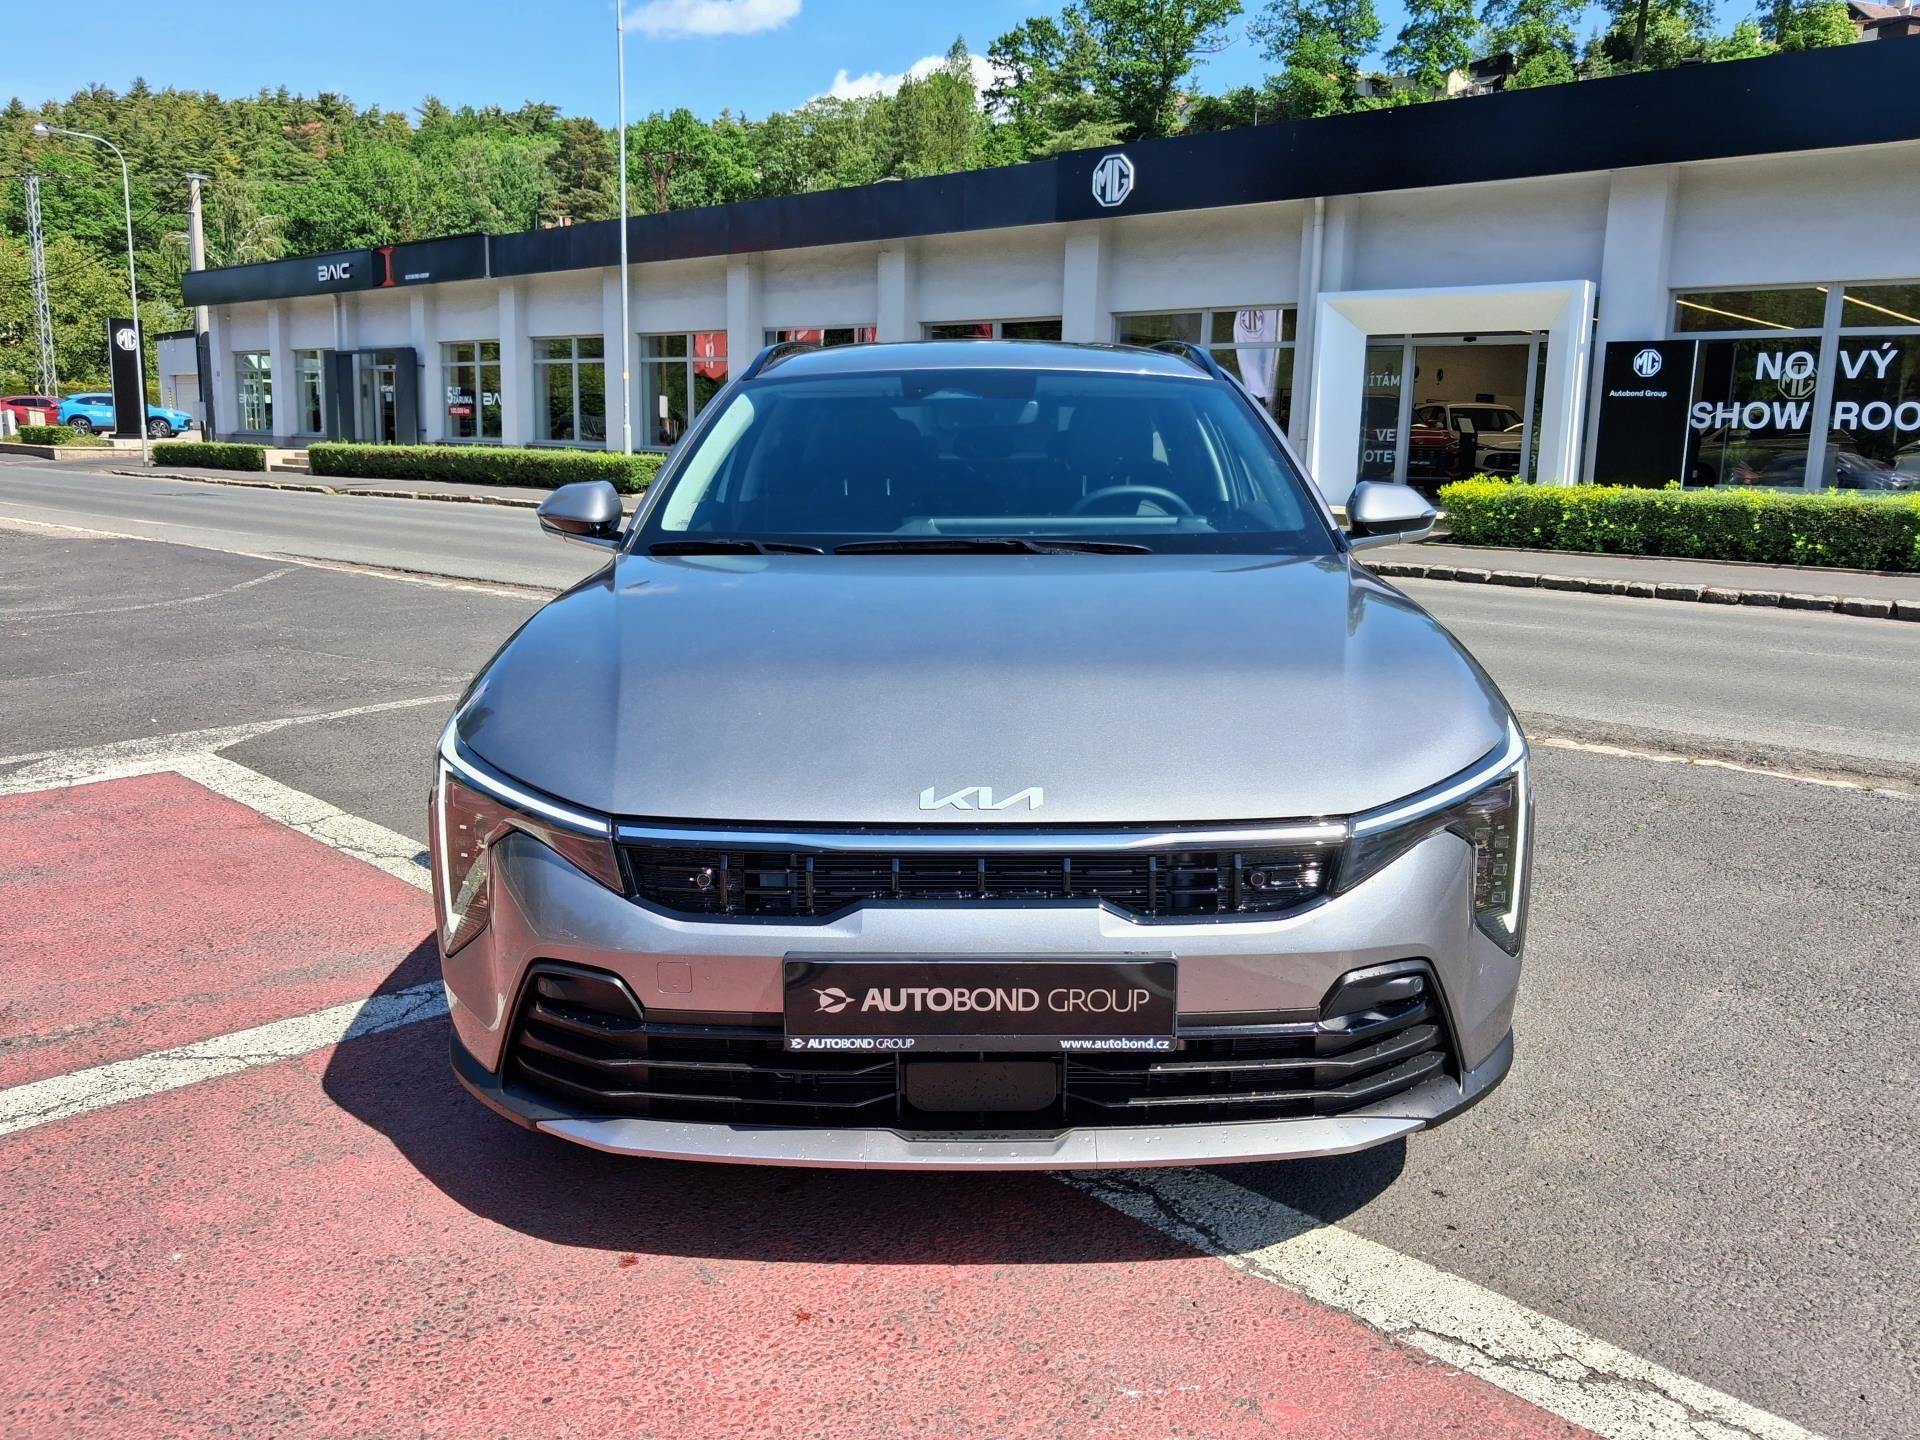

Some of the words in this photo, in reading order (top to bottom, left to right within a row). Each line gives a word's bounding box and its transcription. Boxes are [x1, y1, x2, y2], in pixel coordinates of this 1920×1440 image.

[1096, 158, 1130, 203] MG
[318, 263, 350, 281] BAIC
[1635, 350, 1660, 375] MG
[1645, 390, 1667, 398] Group
[1690, 401, 1810, 430] SHOW
[860, 987, 1040, 1012] AUTOBOND
[1047, 988, 1150, 1012] GROUP
[807, 1038, 874, 1048] AUTOBOND
[876, 1038, 914, 1048] GROUP
[1060, 1037, 1170, 1049] www.autobond.cz
